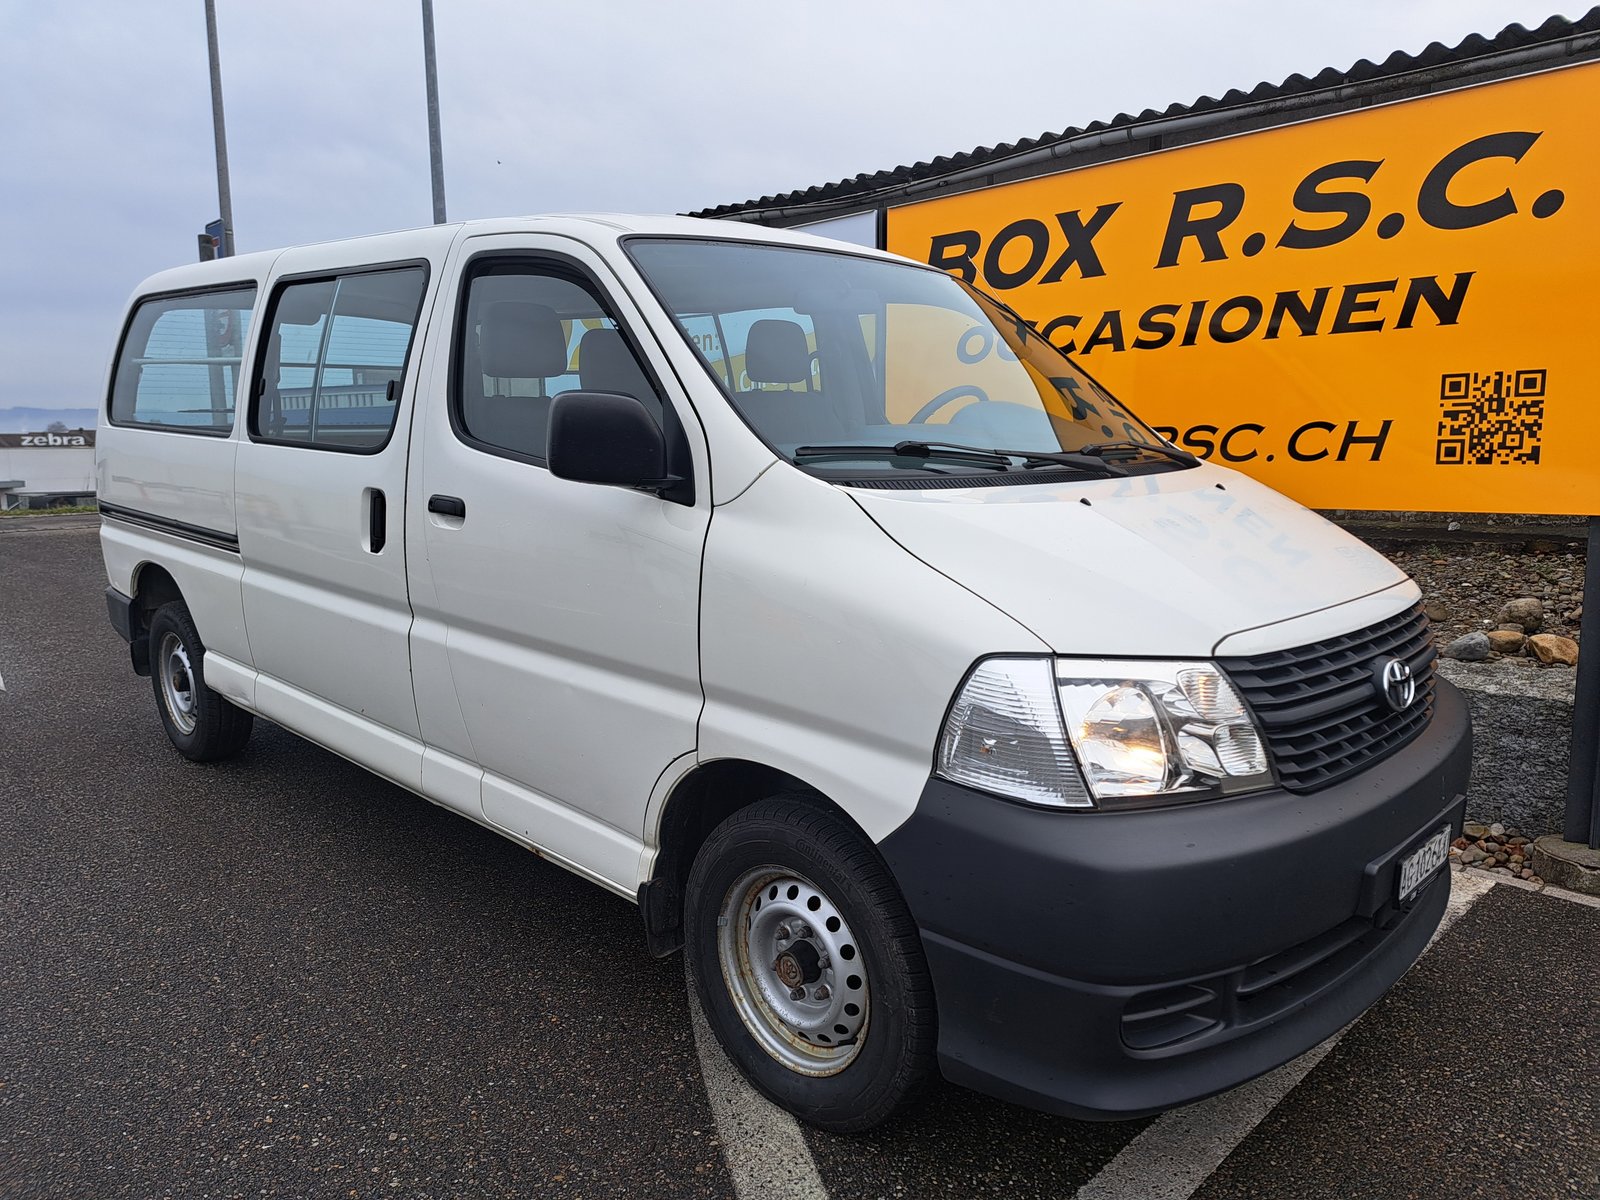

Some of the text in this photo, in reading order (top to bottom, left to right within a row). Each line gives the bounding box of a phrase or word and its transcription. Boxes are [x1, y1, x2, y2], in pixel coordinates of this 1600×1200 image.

[928, 131, 1565, 290] BOX R.S.C.
[21, 433, 85, 446] zebra
